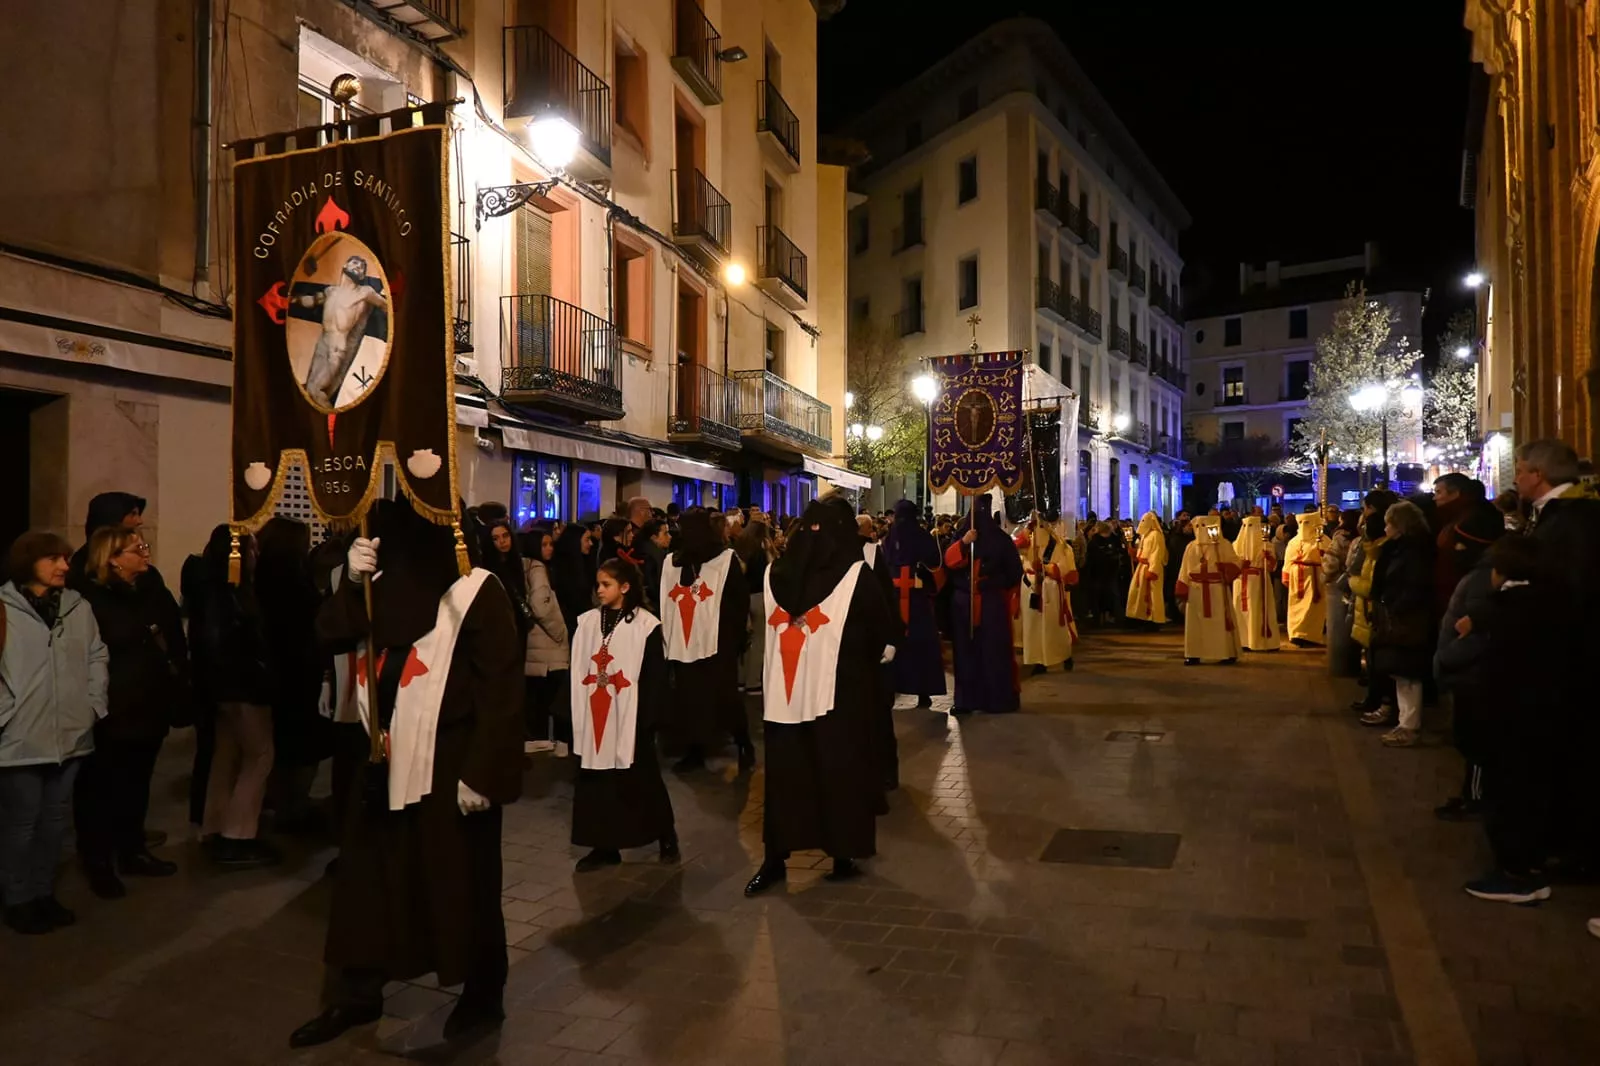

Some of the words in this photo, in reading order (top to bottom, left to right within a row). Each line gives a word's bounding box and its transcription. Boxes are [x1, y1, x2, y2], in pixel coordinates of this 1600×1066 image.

[253, 181, 319, 259] COFRADIA
[323, 171, 343, 188] DE
[314, 455, 367, 473] ESCA
